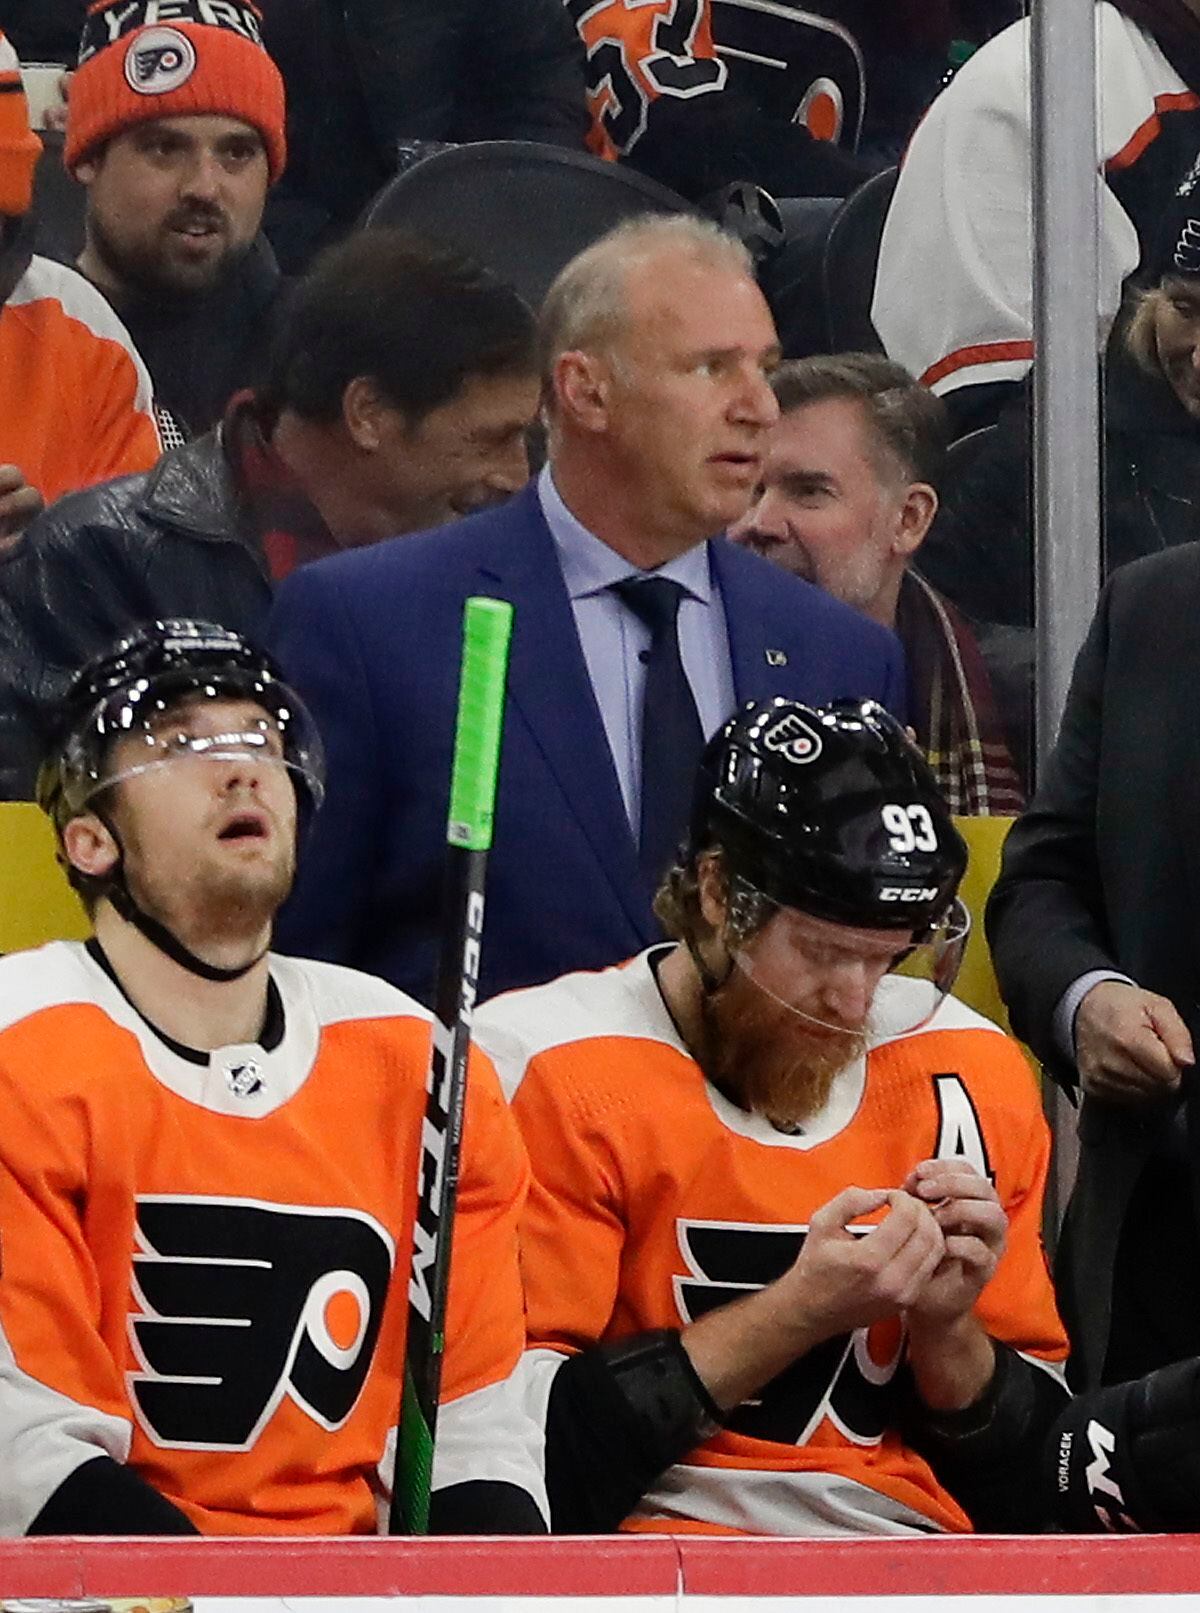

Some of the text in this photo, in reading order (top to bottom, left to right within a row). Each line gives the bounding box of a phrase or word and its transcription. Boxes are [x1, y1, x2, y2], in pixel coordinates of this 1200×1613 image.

[881, 804, 938, 852] 93
[879, 887, 938, 902] CCM
[459, 890, 485, 1032] CCM
[407, 1012, 457, 1323] CCM
[931, 1073, 996, 1187] A
[1059, 1431, 1074, 1493] VORACEK
